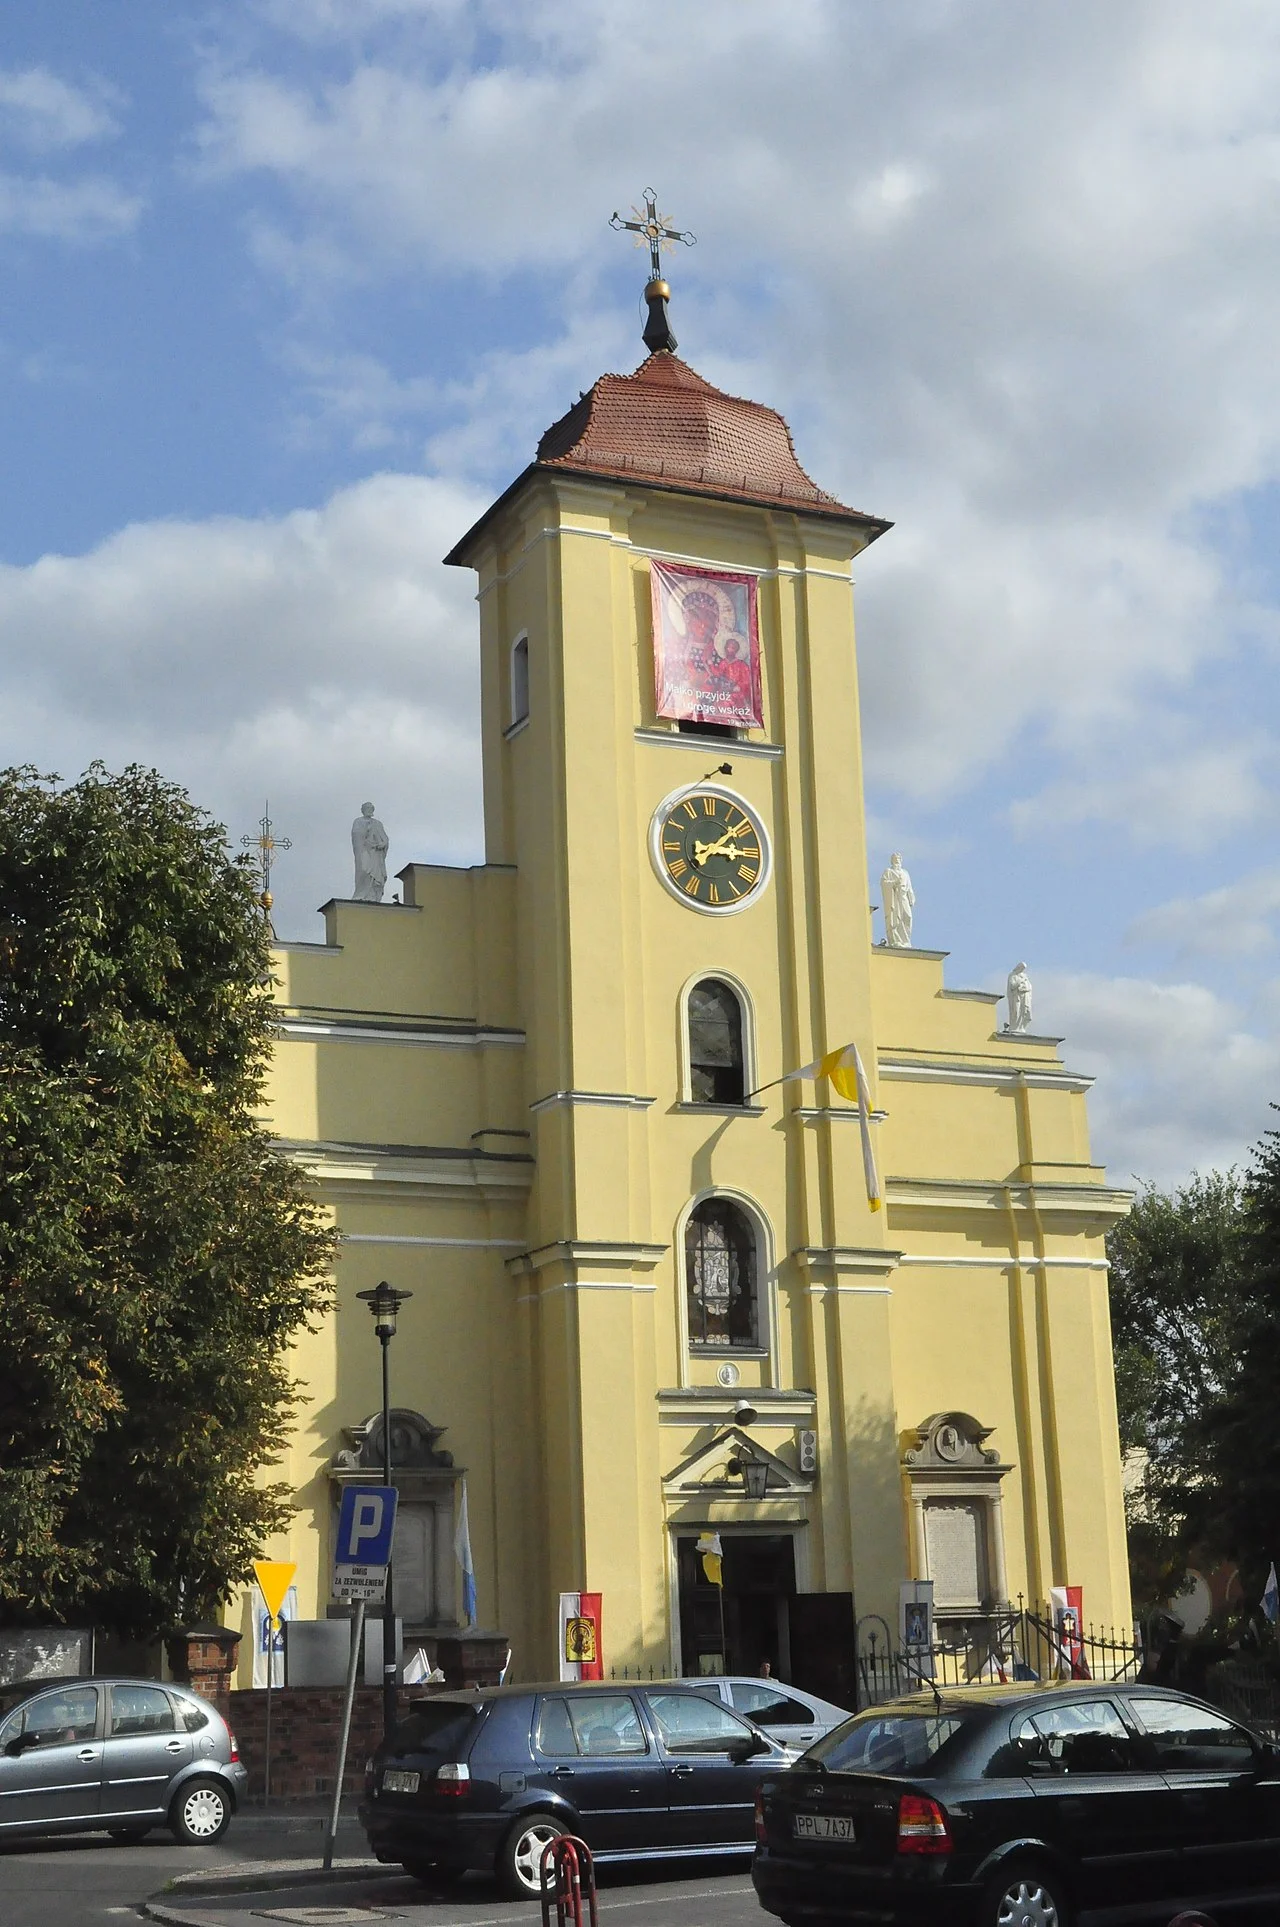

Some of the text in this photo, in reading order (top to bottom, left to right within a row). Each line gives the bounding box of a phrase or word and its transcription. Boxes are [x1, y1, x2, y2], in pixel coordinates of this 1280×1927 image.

[696, 690, 731, 702] przyjdź
[718, 705, 751, 716] wskaż
[349, 1495, 384, 1555] P
[344, 1578, 384, 1587] ZEZWOLENIEM
[341, 1588, 349, 1596] OD
[798, 1817, 851, 1837] PPL 7A37
